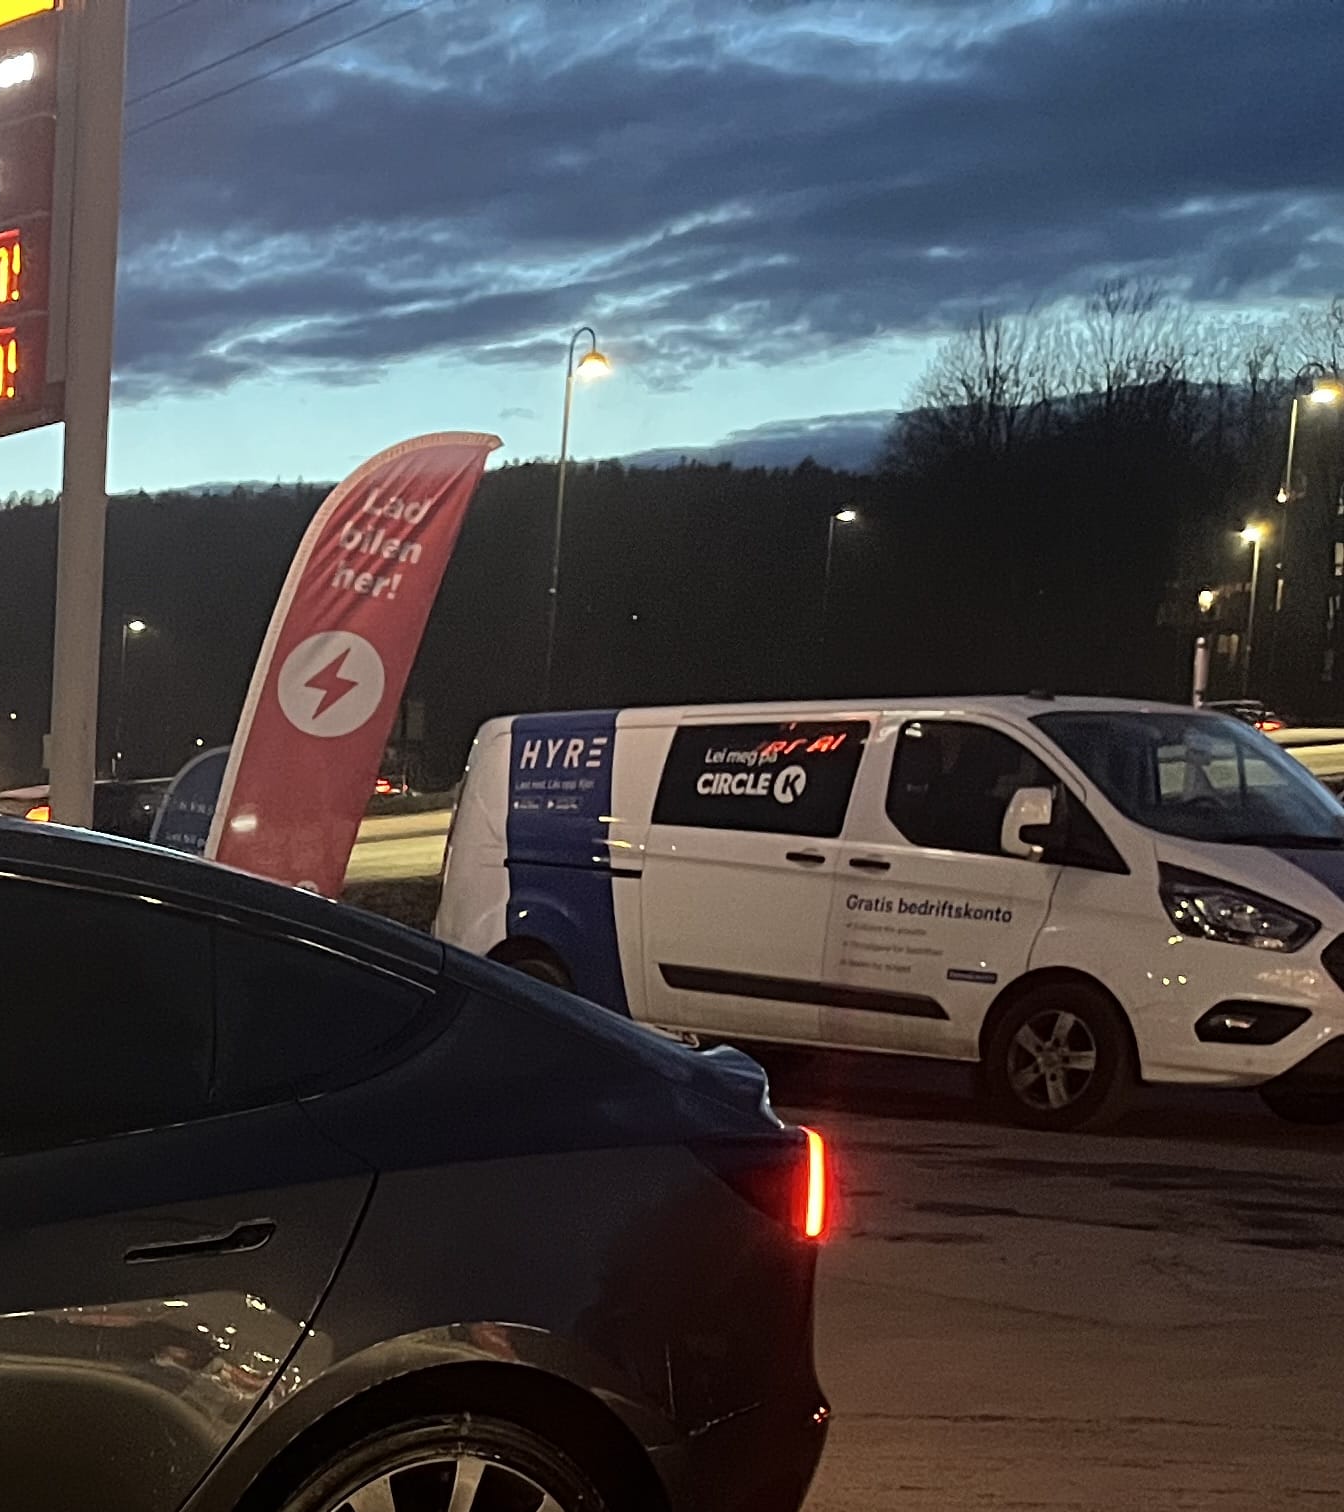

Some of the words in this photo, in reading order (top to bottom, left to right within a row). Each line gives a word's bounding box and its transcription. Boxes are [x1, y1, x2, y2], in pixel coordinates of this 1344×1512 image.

[362, 488, 433, 524] Lad
[339, 521, 422, 564] bilen
[331, 560, 402, 599] her!
[519, 737, 608, 770] HYRE
[725, 750, 758, 767] meg
[696, 772, 772, 796] CIRCLE
[846, 894, 893, 912] Gratis
[897, 897, 1013, 923] bedriftskonto
